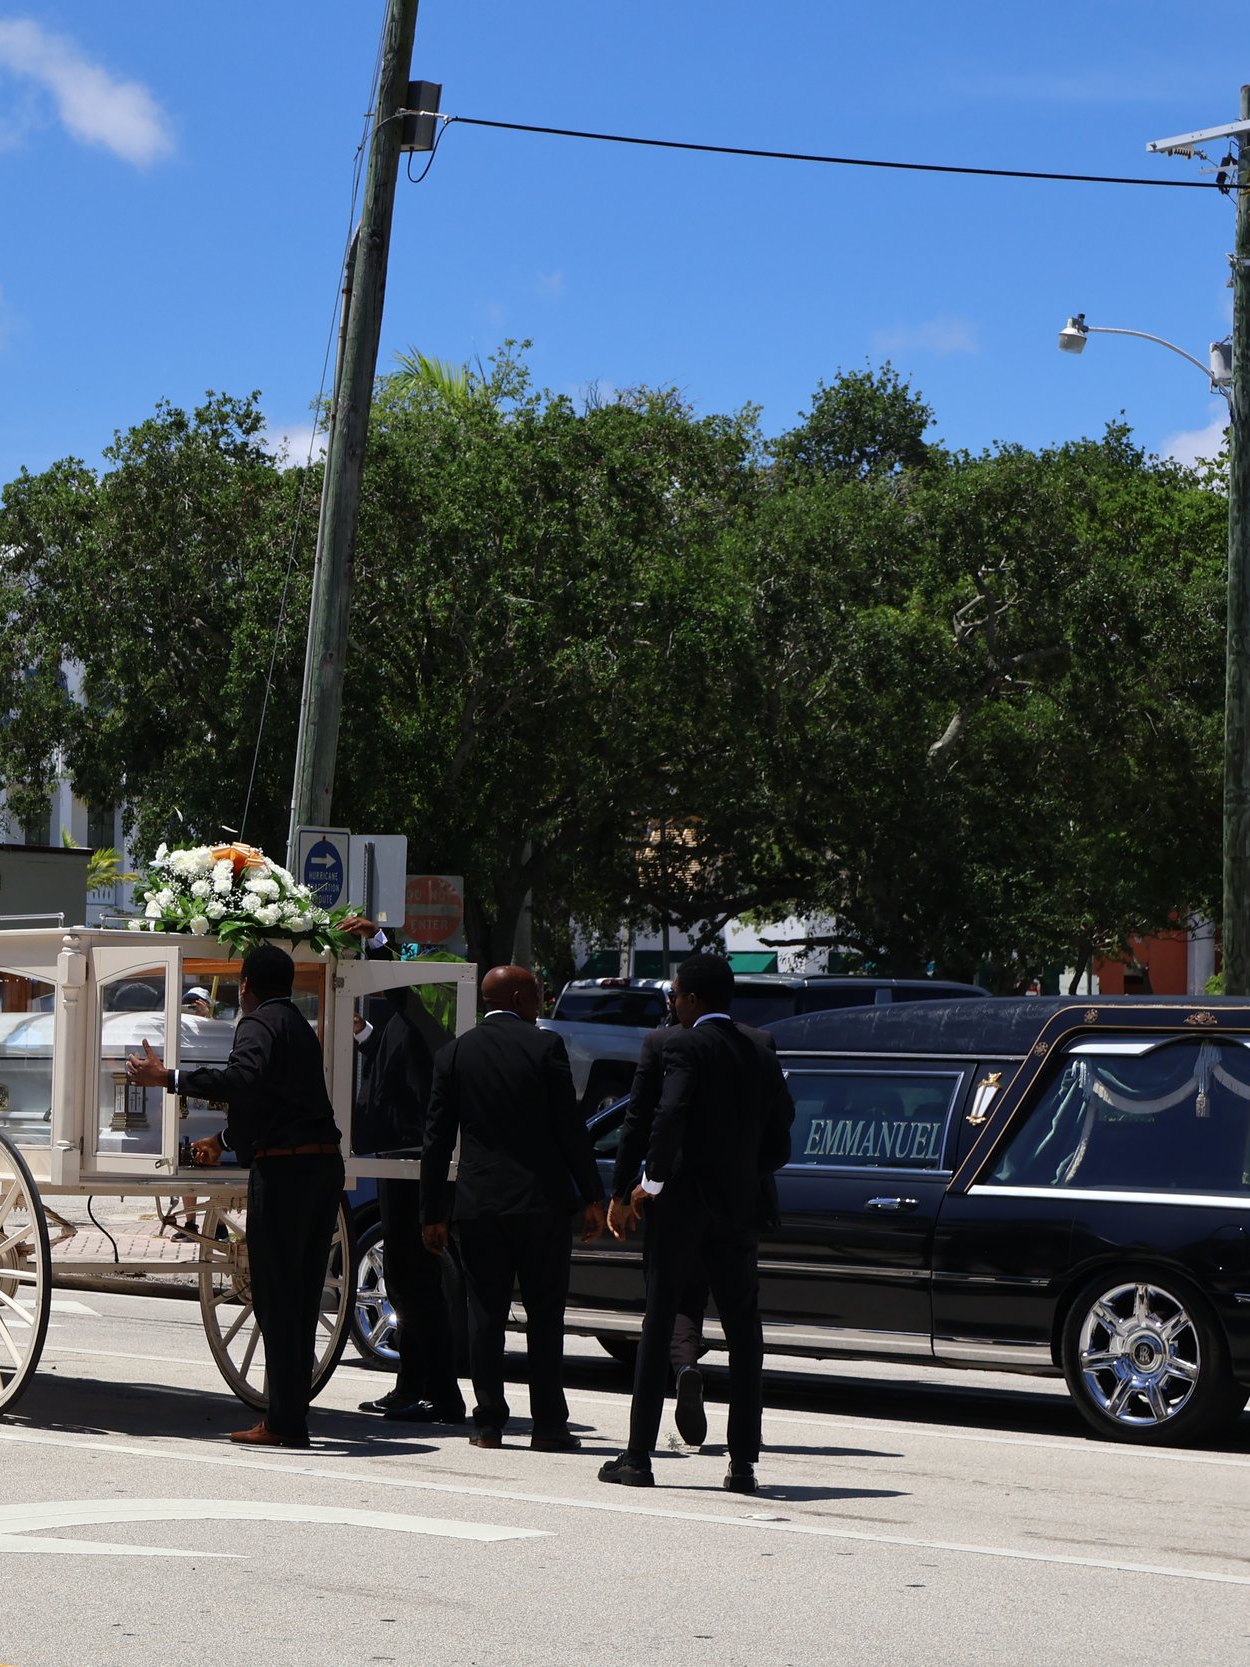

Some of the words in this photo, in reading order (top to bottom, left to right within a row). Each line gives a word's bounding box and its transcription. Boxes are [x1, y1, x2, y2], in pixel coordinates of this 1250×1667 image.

[309, 871, 339, 881] HURRICANE
[311, 882, 340, 893] VACUATION
[410, 919, 448, 930] ENTER
[804, 1119, 941, 1160] EMMANUEL
